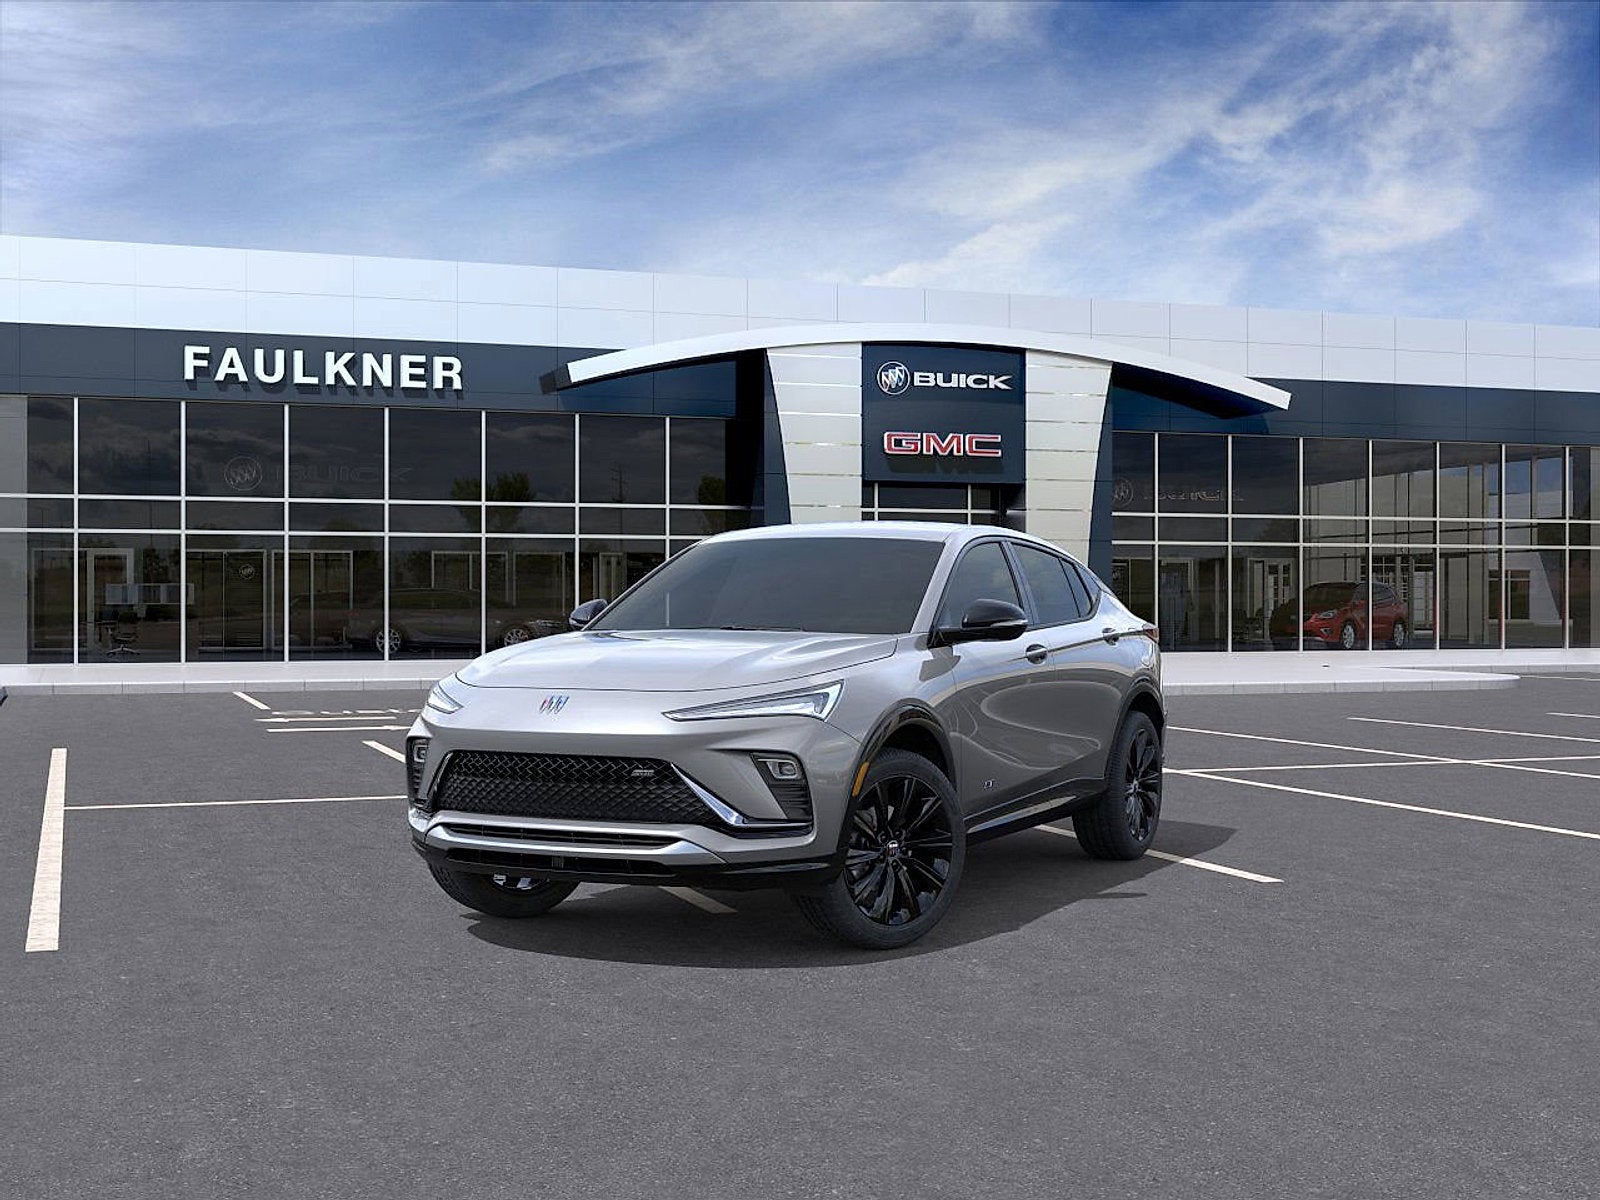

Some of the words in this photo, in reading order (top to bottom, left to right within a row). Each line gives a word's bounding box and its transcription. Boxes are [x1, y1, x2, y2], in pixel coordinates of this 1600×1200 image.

[183, 344, 463, 390] FAULKNER
[913, 371, 1013, 390] BUICK
[883, 431, 1002, 458] GMC
